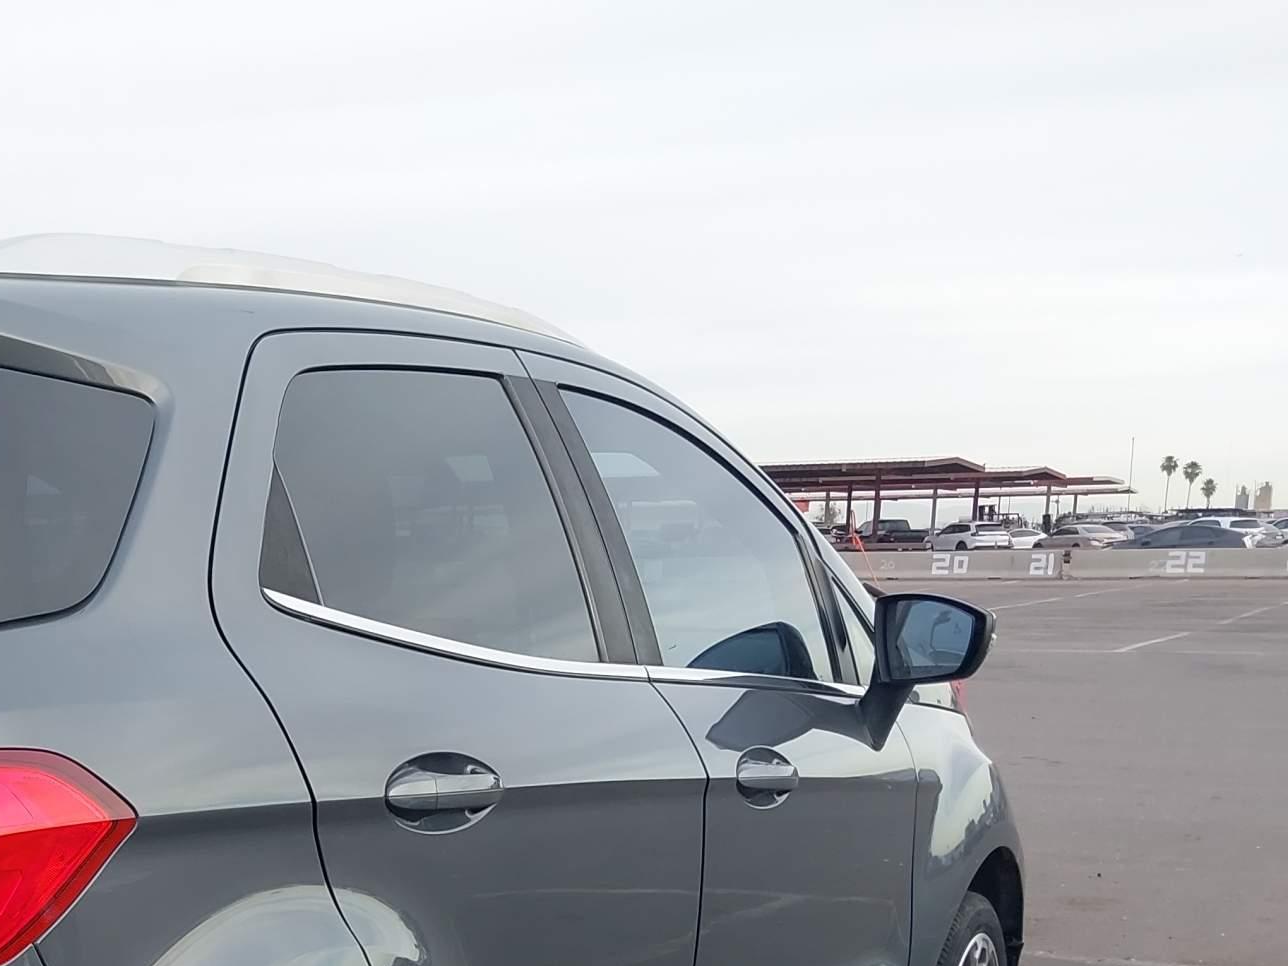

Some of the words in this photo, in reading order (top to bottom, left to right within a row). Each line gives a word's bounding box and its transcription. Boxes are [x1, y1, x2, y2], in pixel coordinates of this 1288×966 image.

[931, 553, 969, 575] 20
[1029, 553, 1055, 575] 21
[1165, 551, 1207, 573] 22
